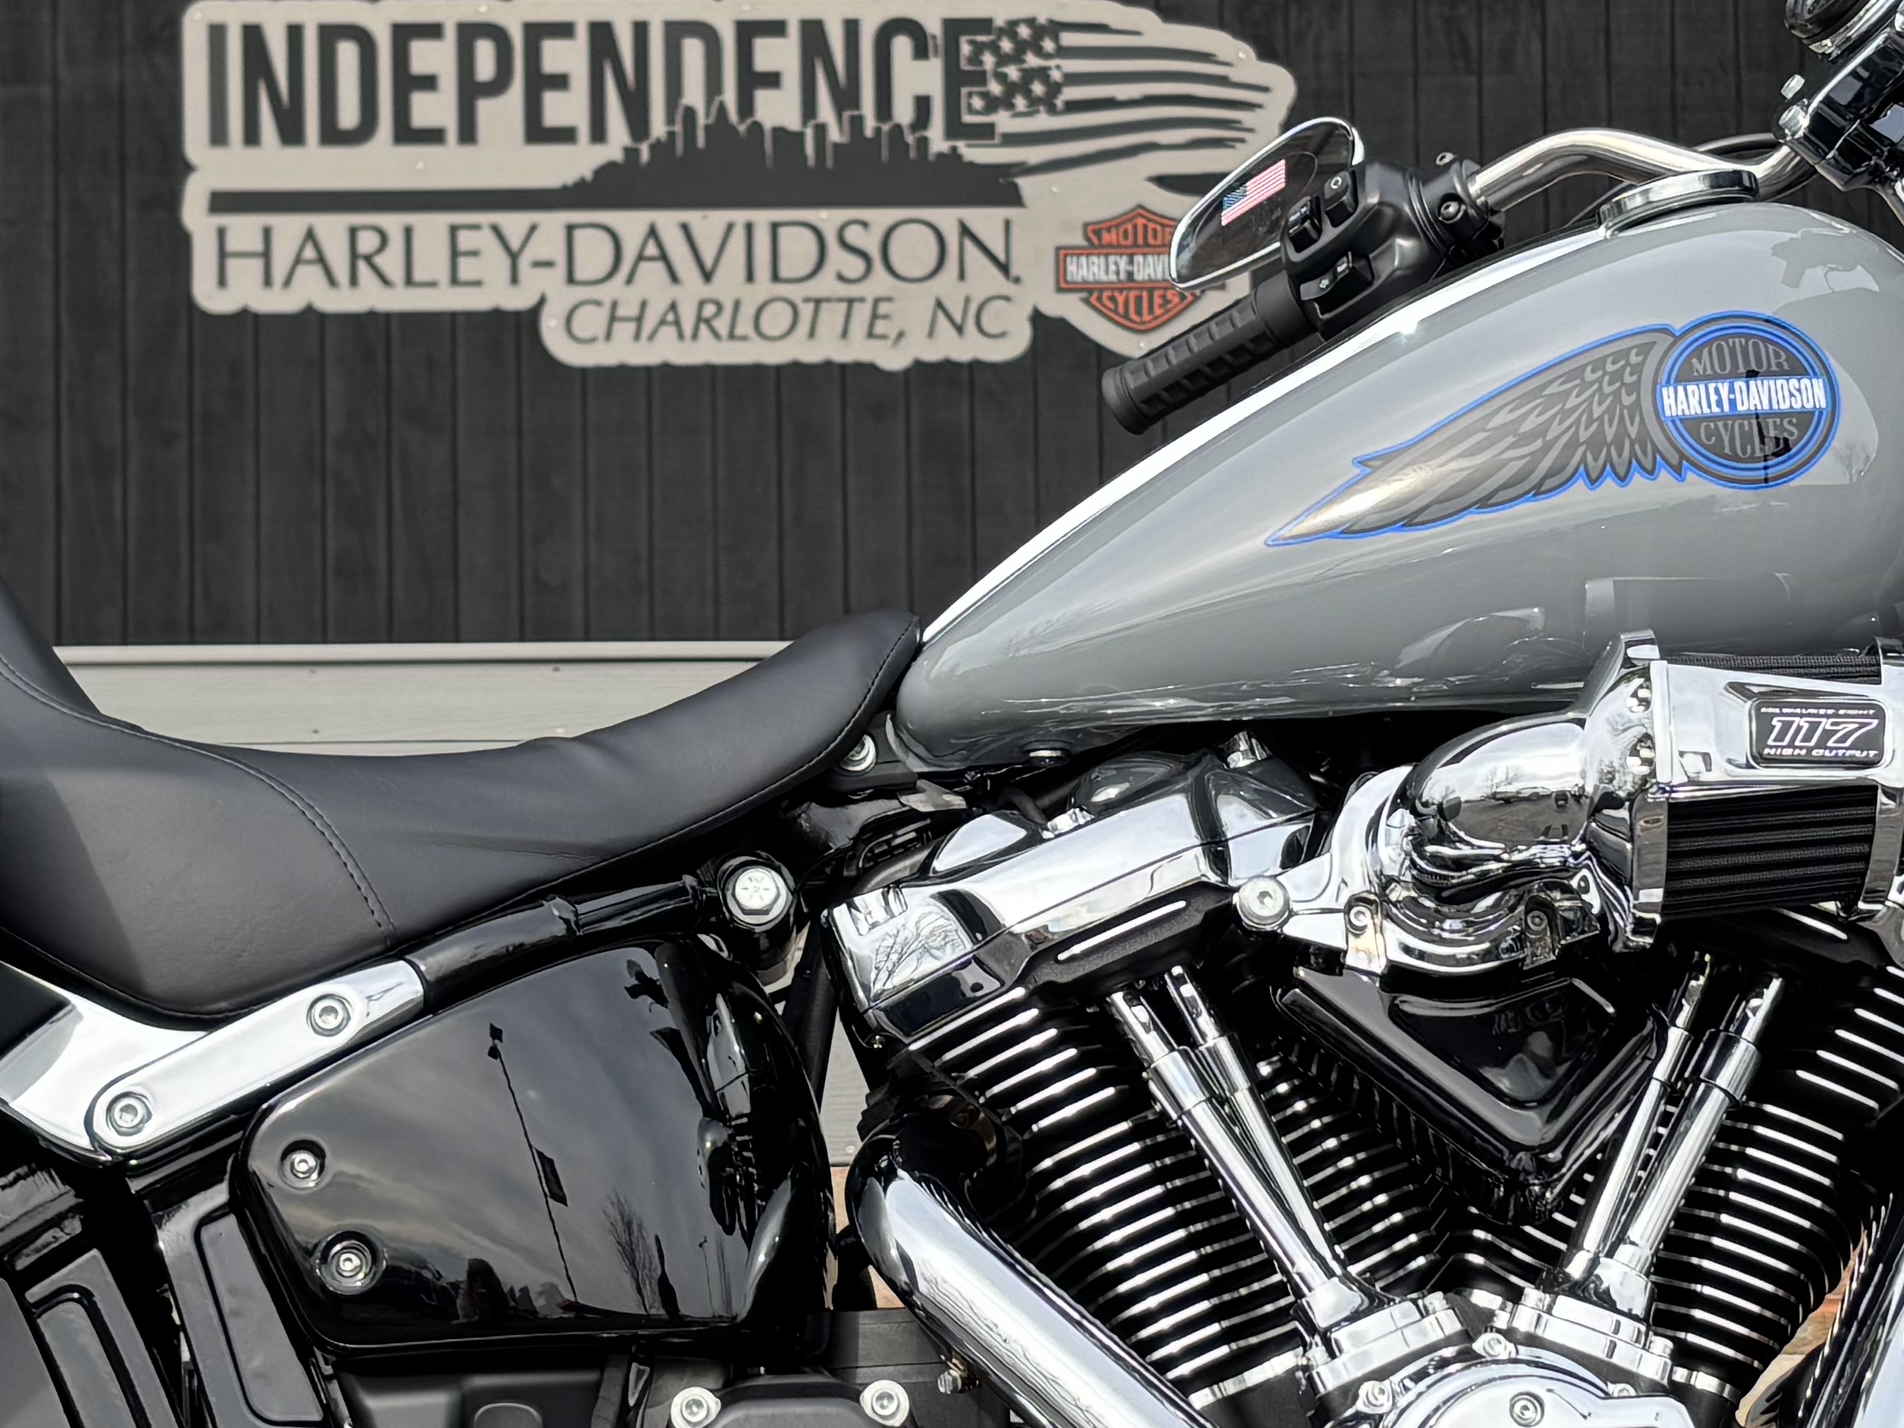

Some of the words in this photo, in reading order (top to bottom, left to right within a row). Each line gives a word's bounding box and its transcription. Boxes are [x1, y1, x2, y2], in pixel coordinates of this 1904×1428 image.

[207, 16, 998, 149] INDEPENDENCE
[562, 297, 908, 349] CHARLOTTE,
[931, 294, 1015, 340] NC
[1101, 290, 1181, 322] CYCLES
[1691, 337, 1791, 376] MOTOR
[1661, 377, 1828, 417] HARLEY-DAVIDSON
[1699, 417, 1799, 459] CYCLES
[1766, 716, 1880, 747] 117
[1762, 747, 1807, 756] HIGH
[1811, 748, 1879, 758] OUTPUT
